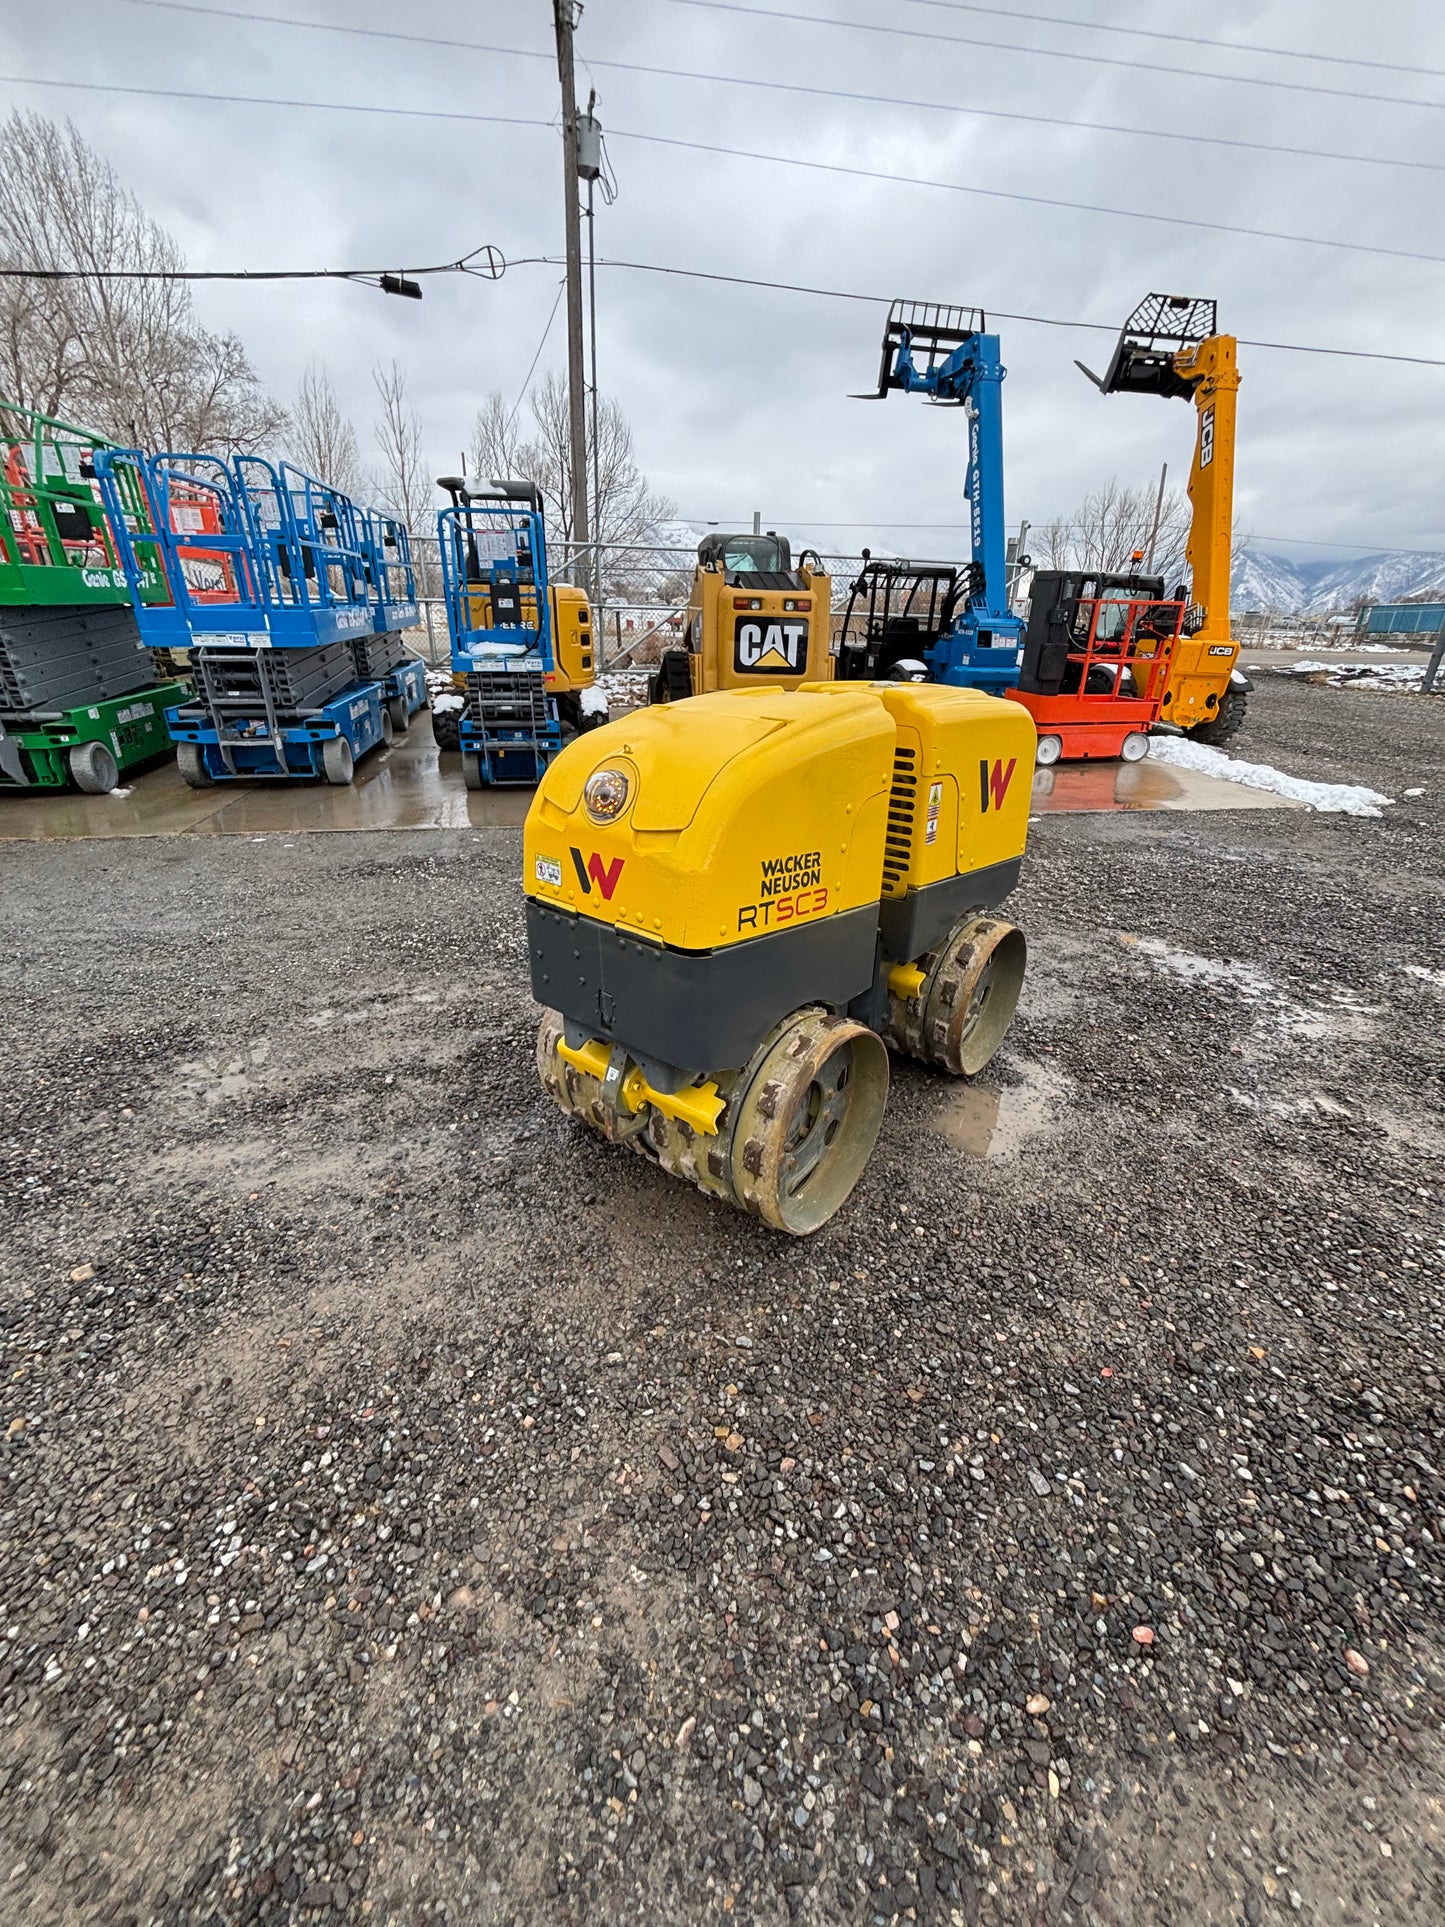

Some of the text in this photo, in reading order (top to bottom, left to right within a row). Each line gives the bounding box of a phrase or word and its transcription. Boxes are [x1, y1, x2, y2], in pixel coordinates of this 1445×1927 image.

[1201, 409, 1214, 468] JCB
[739, 623, 804, 668] CAT
[1208, 646, 1233, 656] JCB
[760, 851, 821, 878] WACKER
[760, 868, 821, 897] NEUSON
[737, 887, 828, 932] RTSC3
